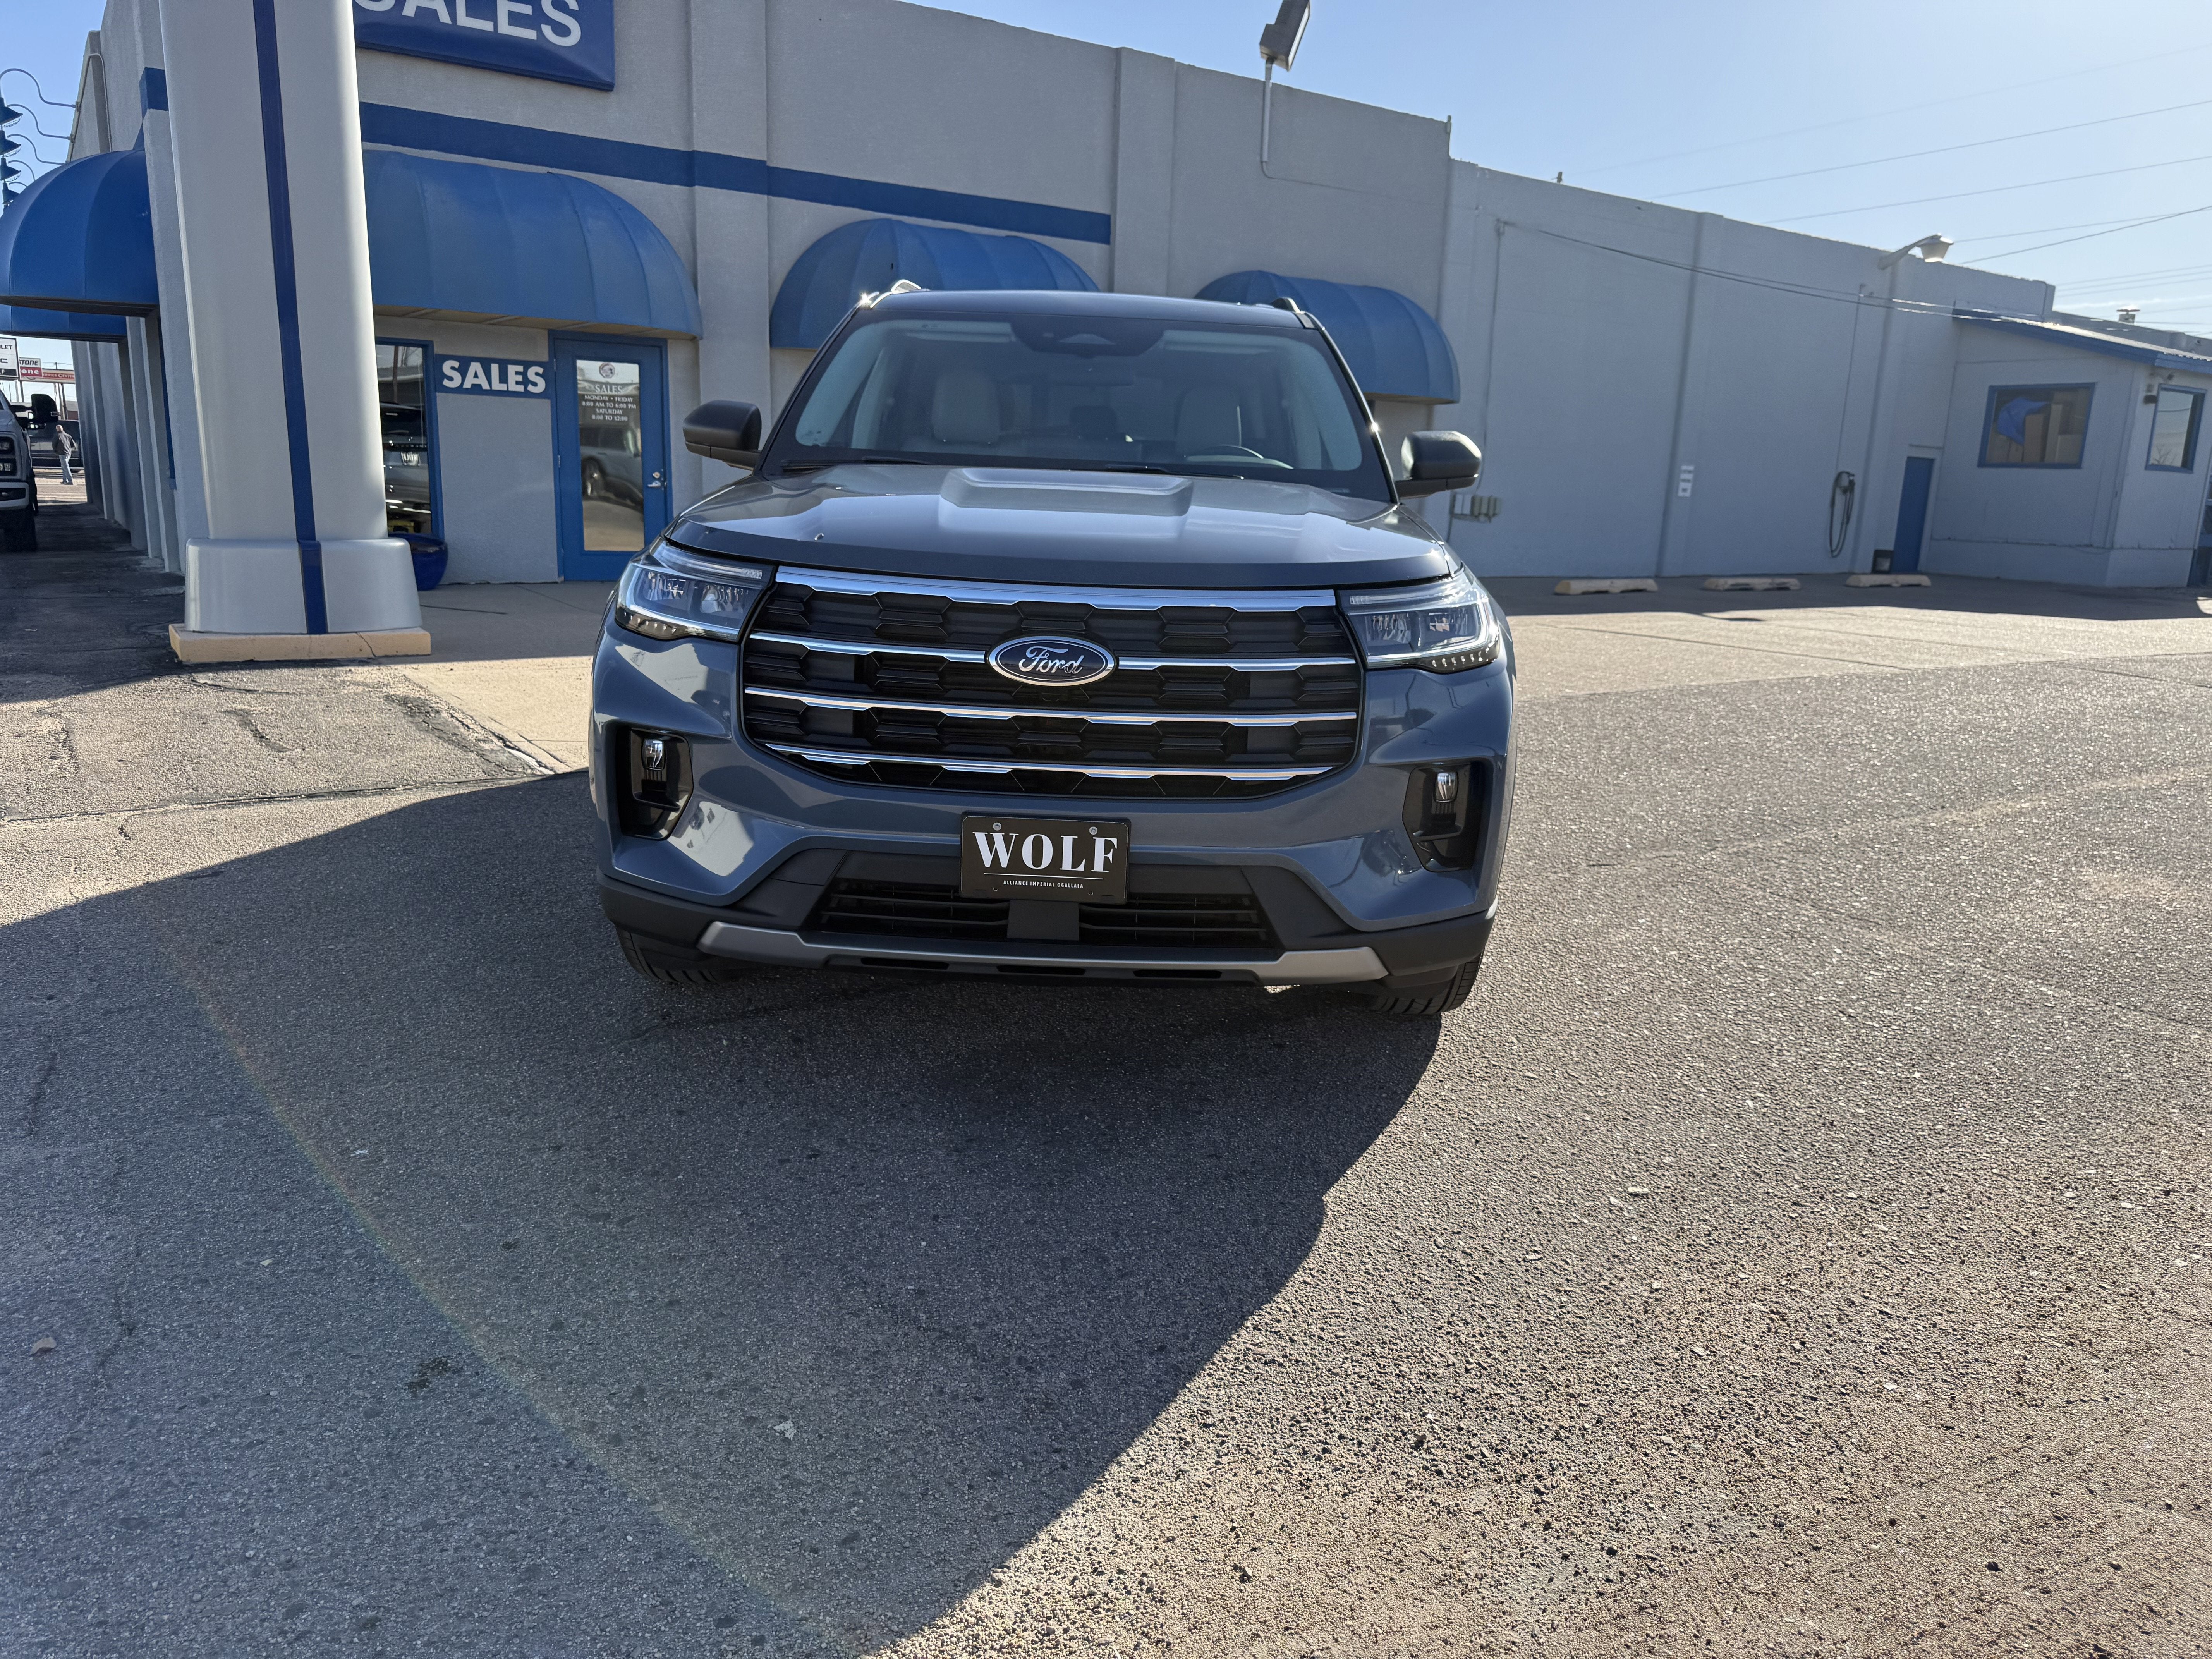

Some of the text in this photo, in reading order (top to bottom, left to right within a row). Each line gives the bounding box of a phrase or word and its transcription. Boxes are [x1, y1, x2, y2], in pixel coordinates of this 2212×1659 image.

[355, 0, 581, 46] LES
[442, 360, 546, 393] SALES
[595, 384, 623, 394] SALES
[1018, 646, 1084, 674] Ford
[972, 831, 1117, 872] WOLF
